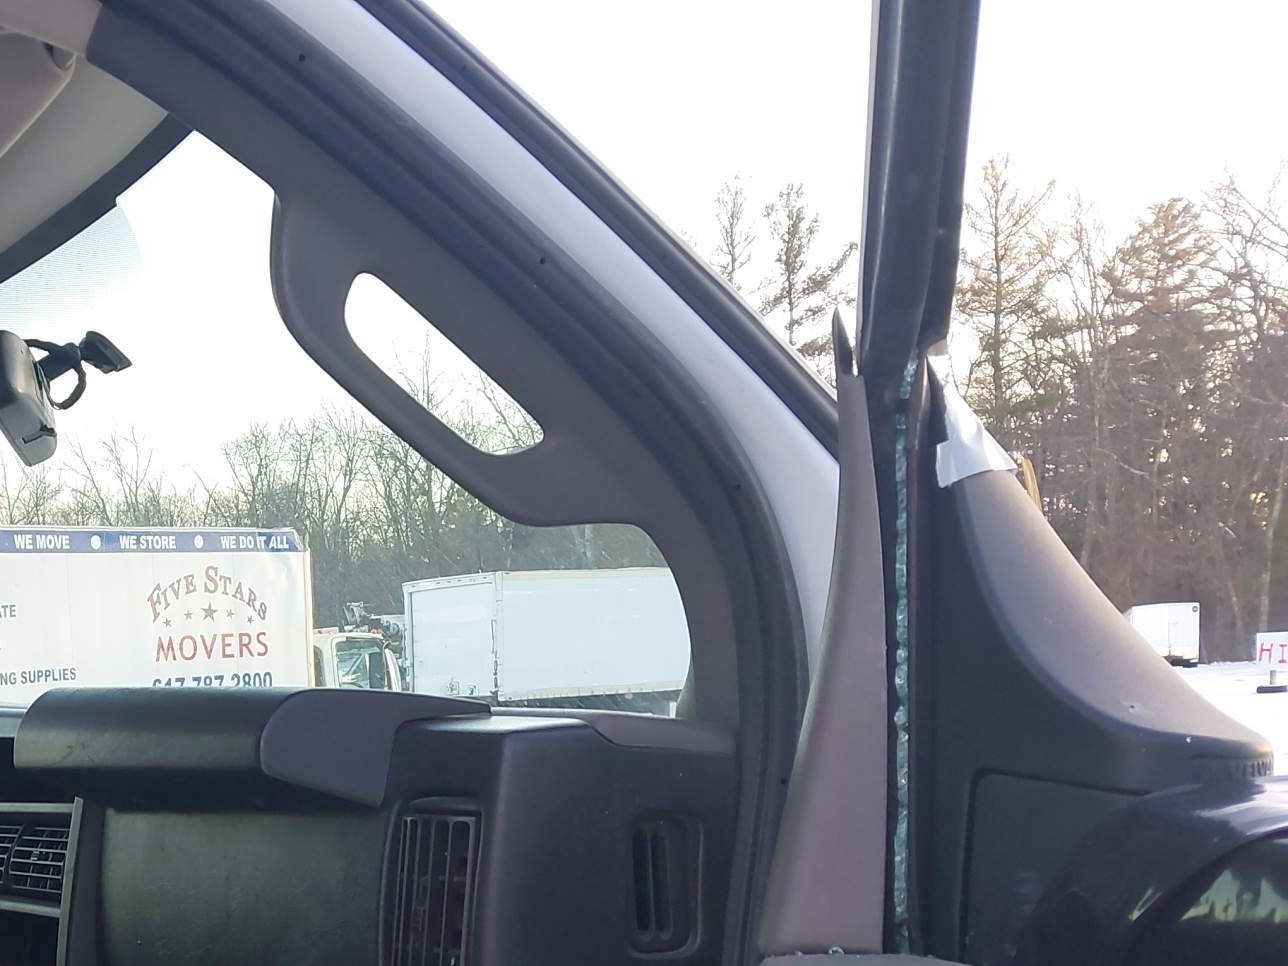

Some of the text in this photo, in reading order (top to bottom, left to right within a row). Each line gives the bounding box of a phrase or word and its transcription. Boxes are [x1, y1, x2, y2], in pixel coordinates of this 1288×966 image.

[14, 534, 34, 549] WE
[37, 534, 70, 550] MOVE
[120, 535, 137, 549] WE
[140, 535, 176, 550] STORE
[221, 535, 237, 549] WE
[240, 535, 255, 549] DO
[257, 535, 267, 549] IT
[268, 535, 290, 549] ALL
[147, 566, 267, 624] FIVE STARS
[156, 632, 269, 662] MOVERS
[20, 667, 77, 684] SUPPLIES
